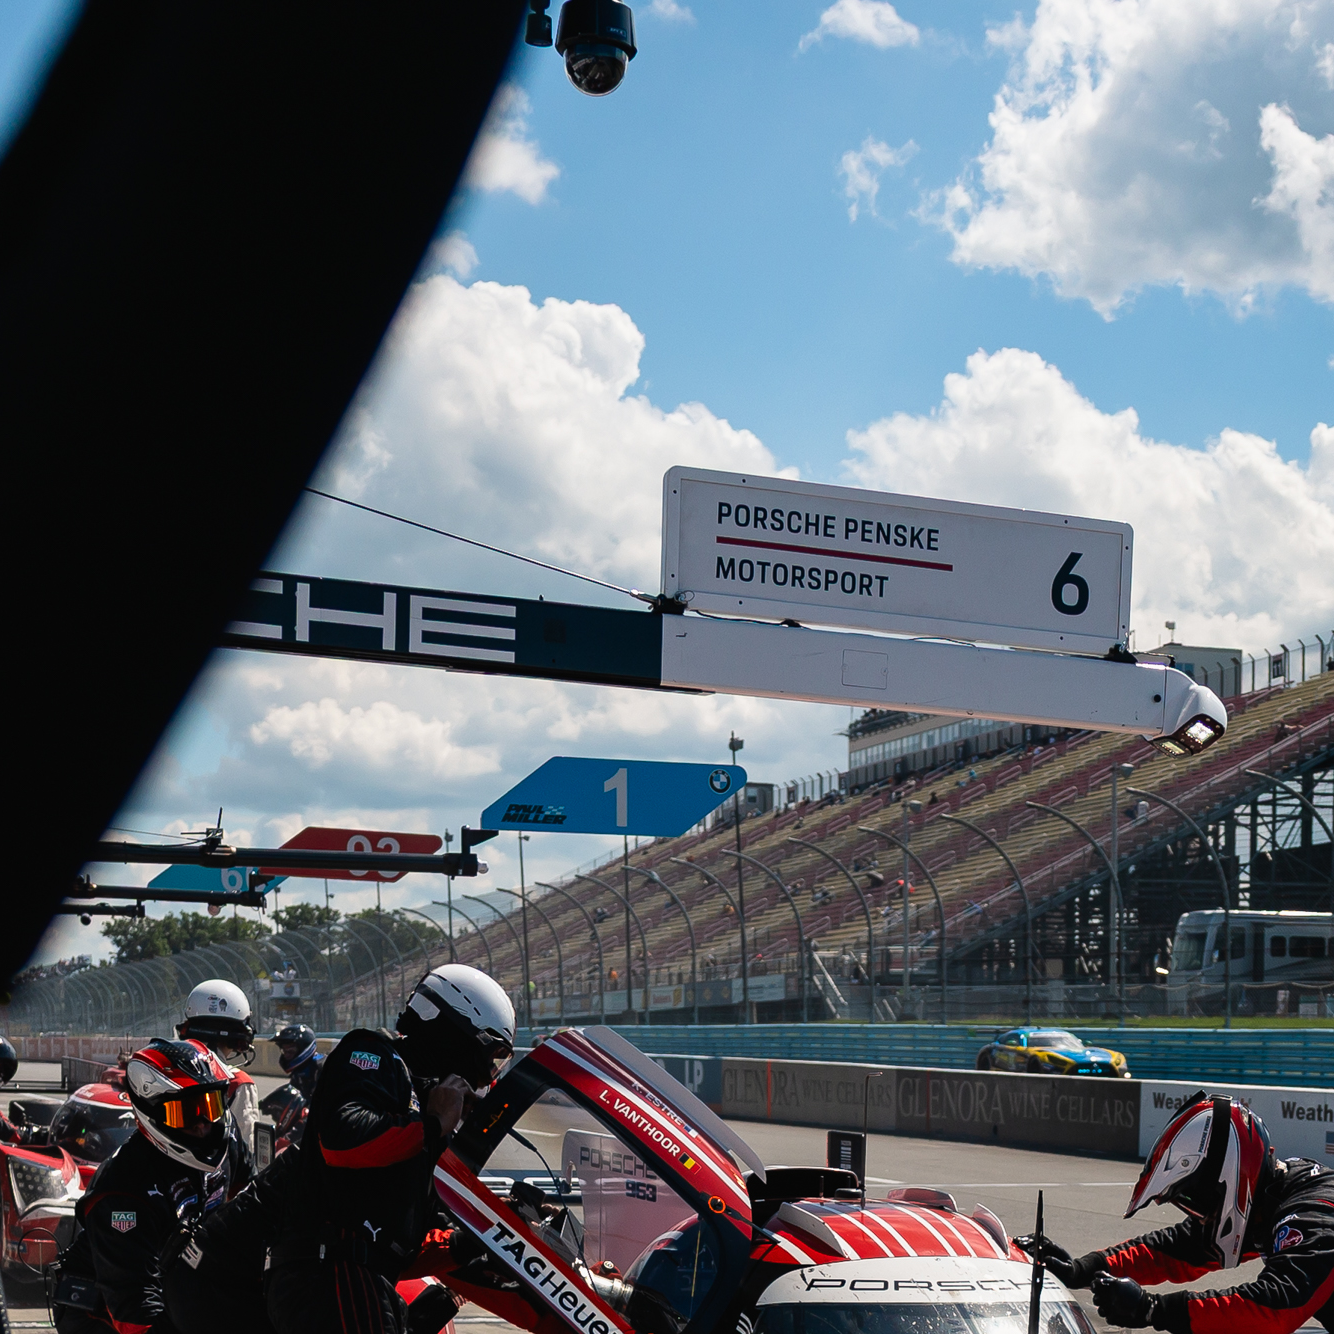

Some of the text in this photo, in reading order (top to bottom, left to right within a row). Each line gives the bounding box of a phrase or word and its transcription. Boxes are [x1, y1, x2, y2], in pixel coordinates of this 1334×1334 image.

[716, 501, 941, 552] PORSCHE PENSKE
[714, 555, 890, 599] MOTORSPORT
[1050, 550, 1091, 617] 6
[501, 812, 567, 825] MILLER
[507, 803, 545, 815] PAUL
[602, 767, 628, 828] 1
[353, 1051, 380, 1063] TAG
[598, 1089, 682, 1158] L. VANTHOOR
[898, 1077, 1006, 1125] GLENORA
[1008, 1090, 1051, 1120] WINE
[1056, 1093, 1135, 1128] CELLARS
[625, 1178, 658, 1203] 963
[113, 1212, 136, 1220] TAG
